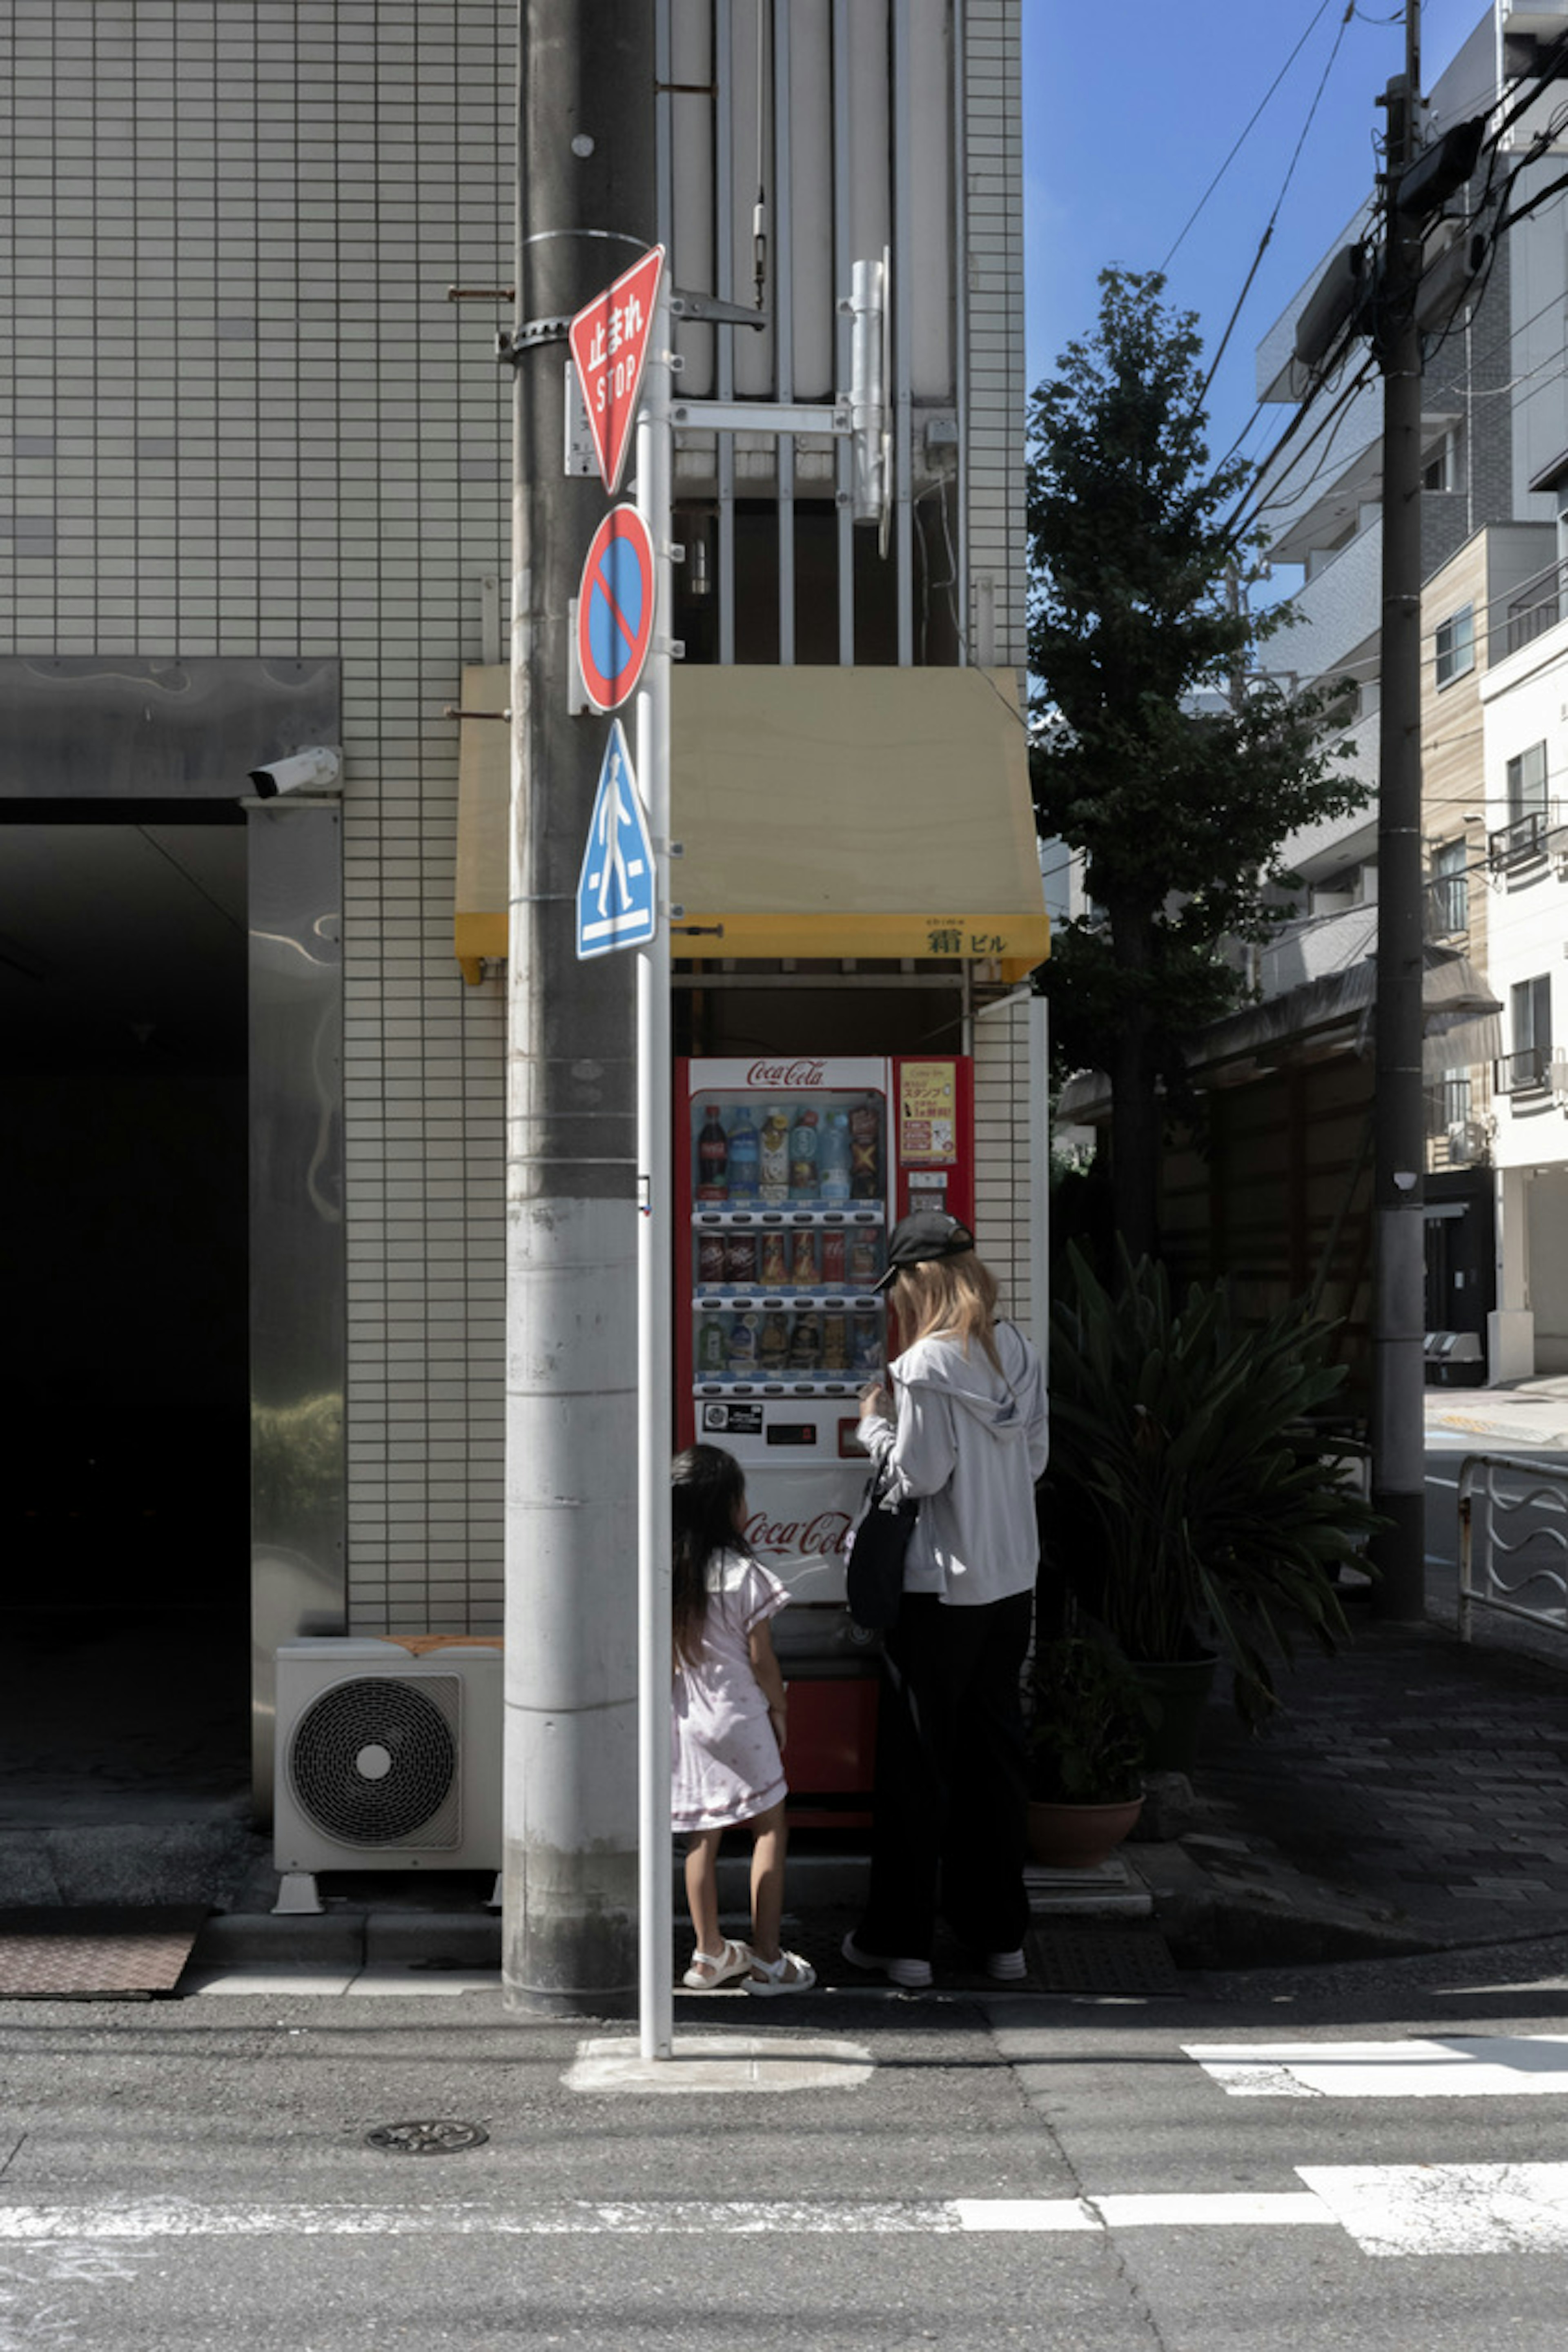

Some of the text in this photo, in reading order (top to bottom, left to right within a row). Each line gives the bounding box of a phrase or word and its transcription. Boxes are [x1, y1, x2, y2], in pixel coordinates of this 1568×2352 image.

[588, 294, 644, 372] 止まれ
[597, 354, 635, 412] STOP
[746, 1060, 827, 1085] Coca-Cola
